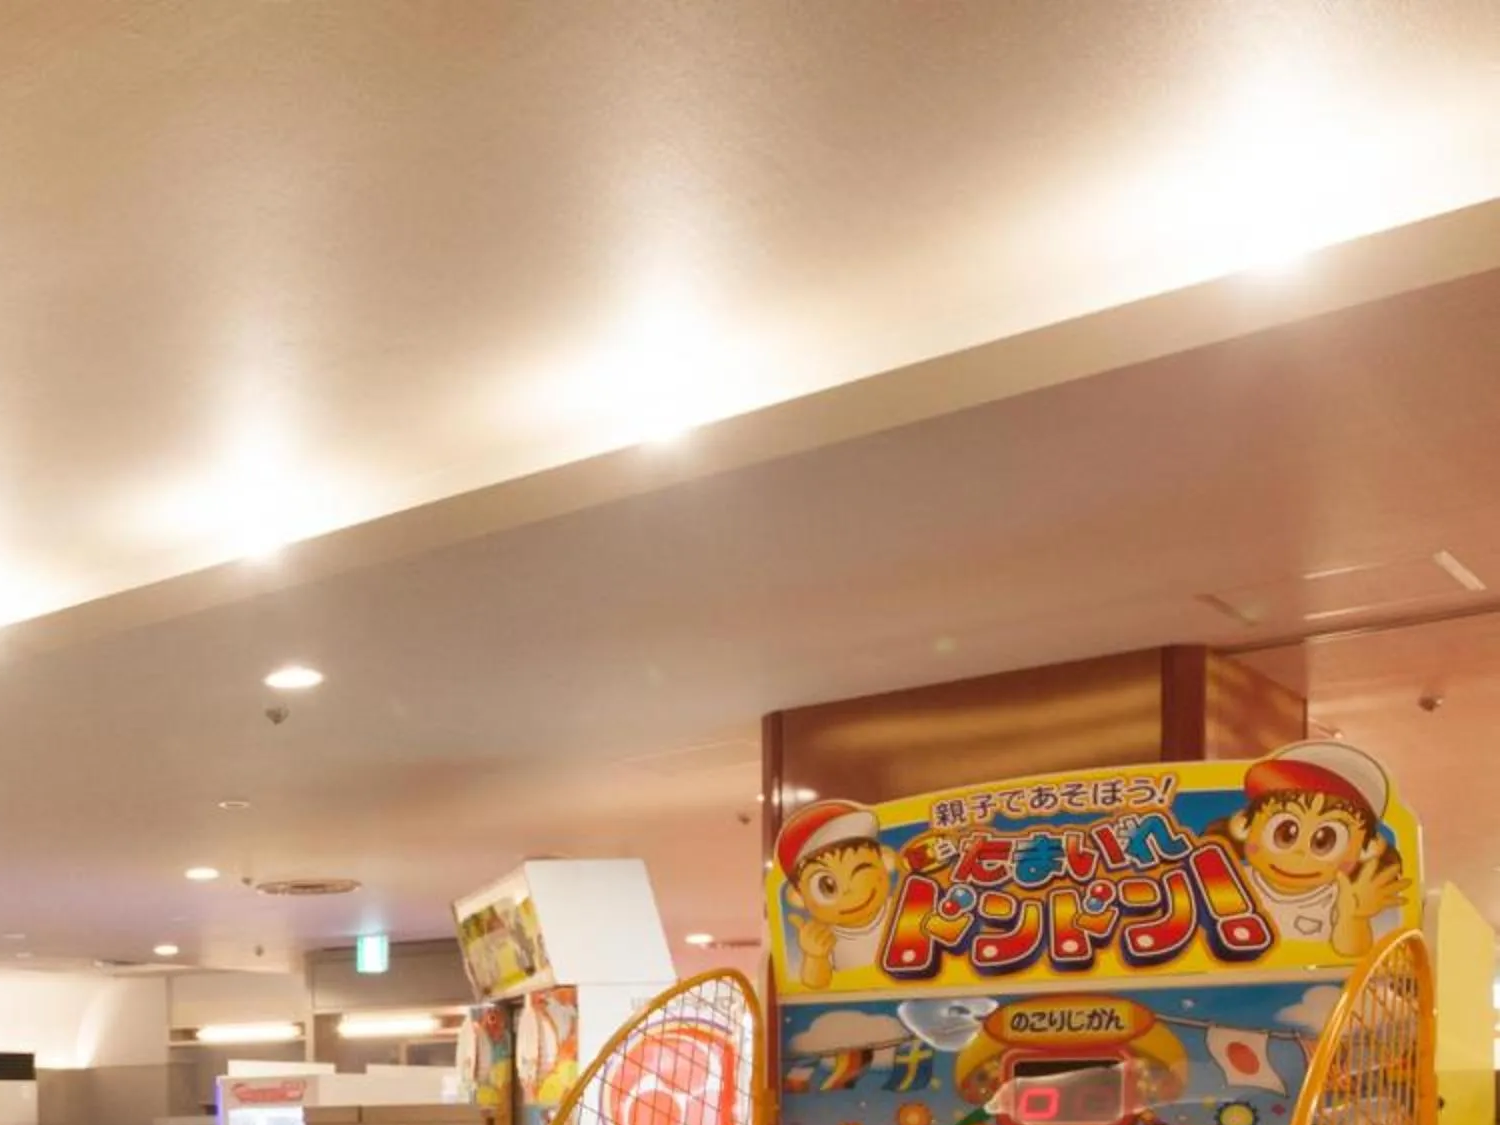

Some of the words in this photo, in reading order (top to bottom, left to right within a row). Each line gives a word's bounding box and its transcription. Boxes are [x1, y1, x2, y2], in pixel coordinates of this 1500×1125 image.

[1010, 1008, 1124, 1032] のこりじかん
